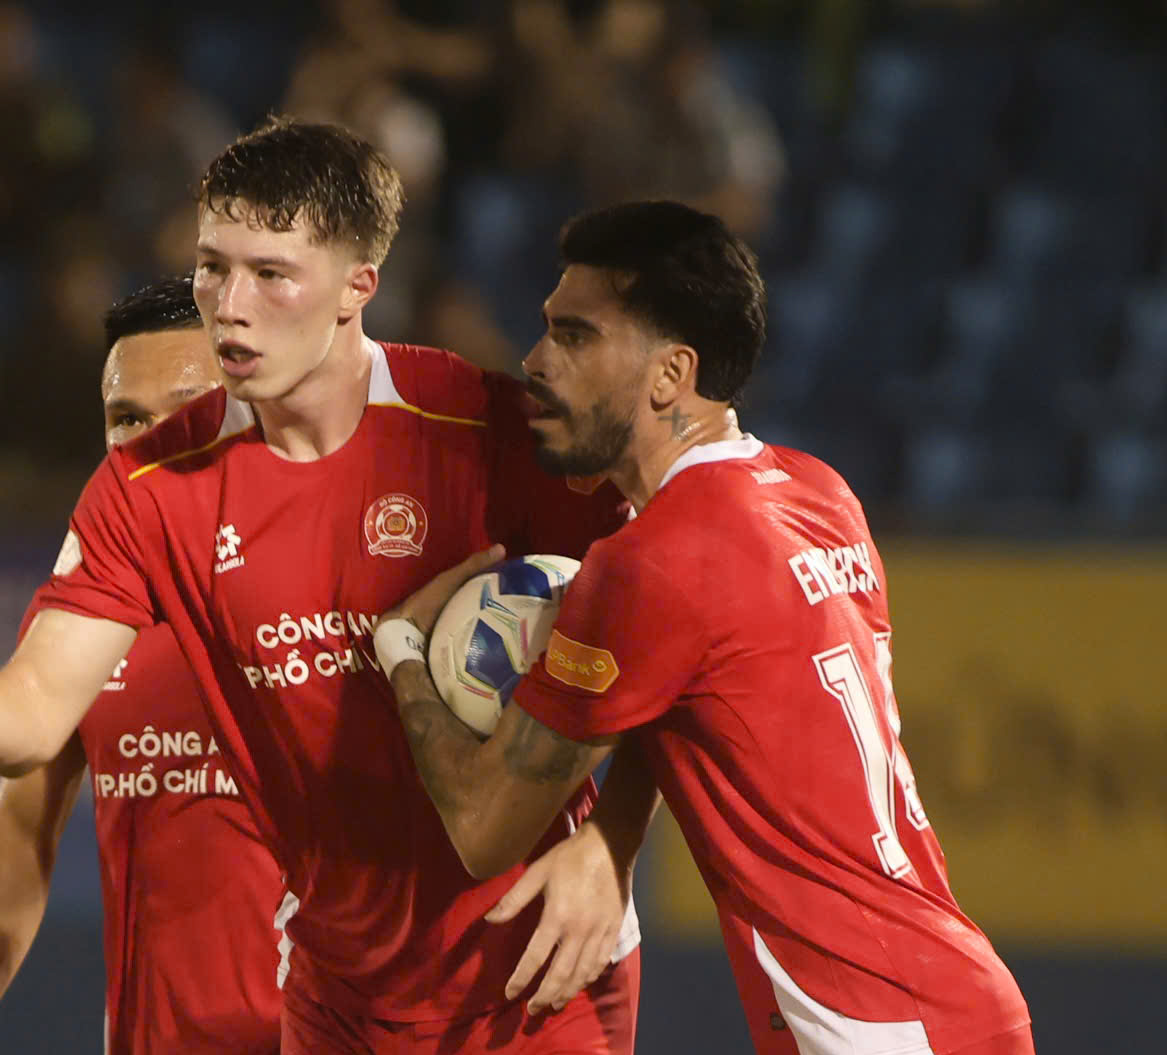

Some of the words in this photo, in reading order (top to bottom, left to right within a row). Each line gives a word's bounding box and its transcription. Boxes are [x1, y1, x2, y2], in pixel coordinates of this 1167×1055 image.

[256, 611, 346, 649] CÔNG
[237, 648, 310, 689] P.HỒ
[119, 725, 203, 758] CÔNG
[208, 735, 222, 756] A
[96, 762, 158, 798] P.HỒ
[163, 762, 209, 794] CHÍ
